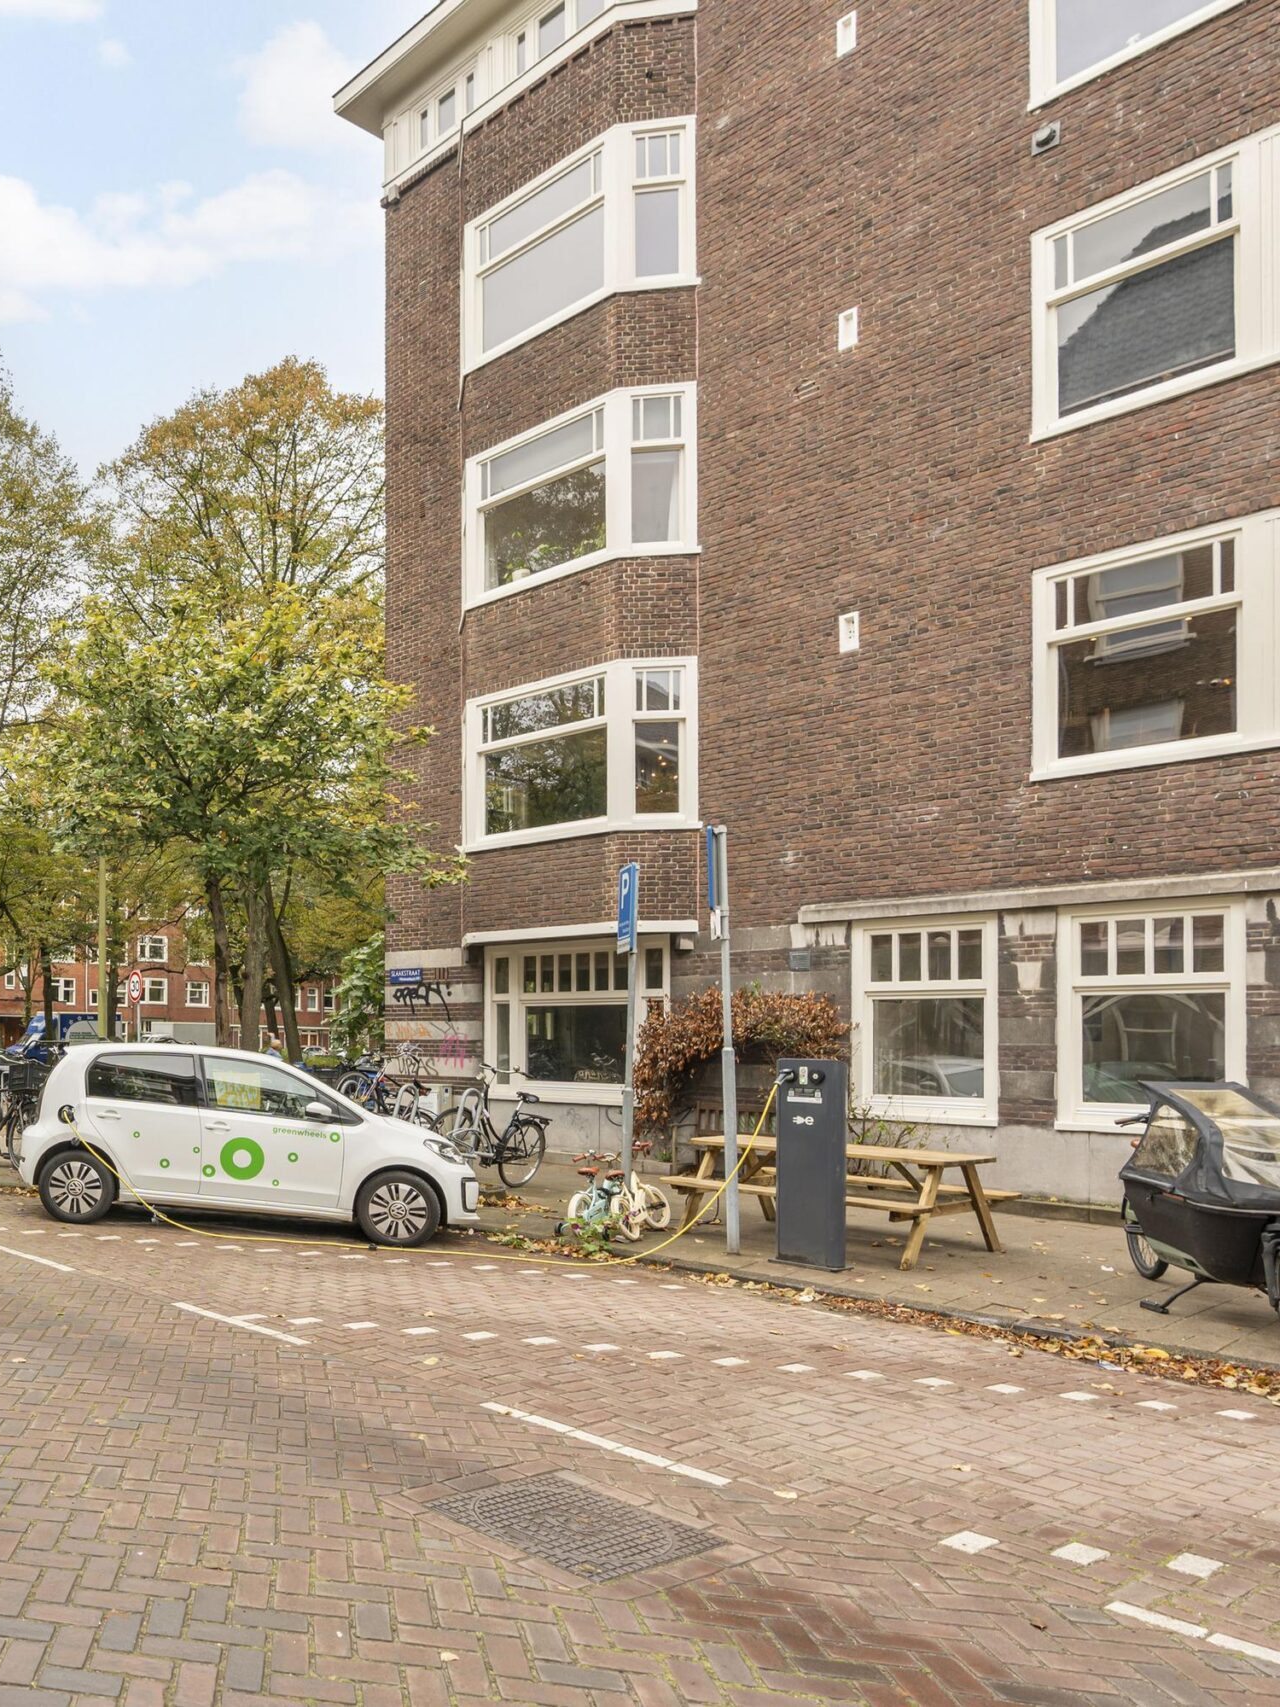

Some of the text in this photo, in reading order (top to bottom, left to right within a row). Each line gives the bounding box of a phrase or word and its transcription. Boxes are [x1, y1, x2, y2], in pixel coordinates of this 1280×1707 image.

[621, 872, 630, 909] P
[390, 969, 421, 977] SLAAKSTRAAT
[131, 980, 139, 991] 30
[272, 1127, 327, 1139] greenwheels
